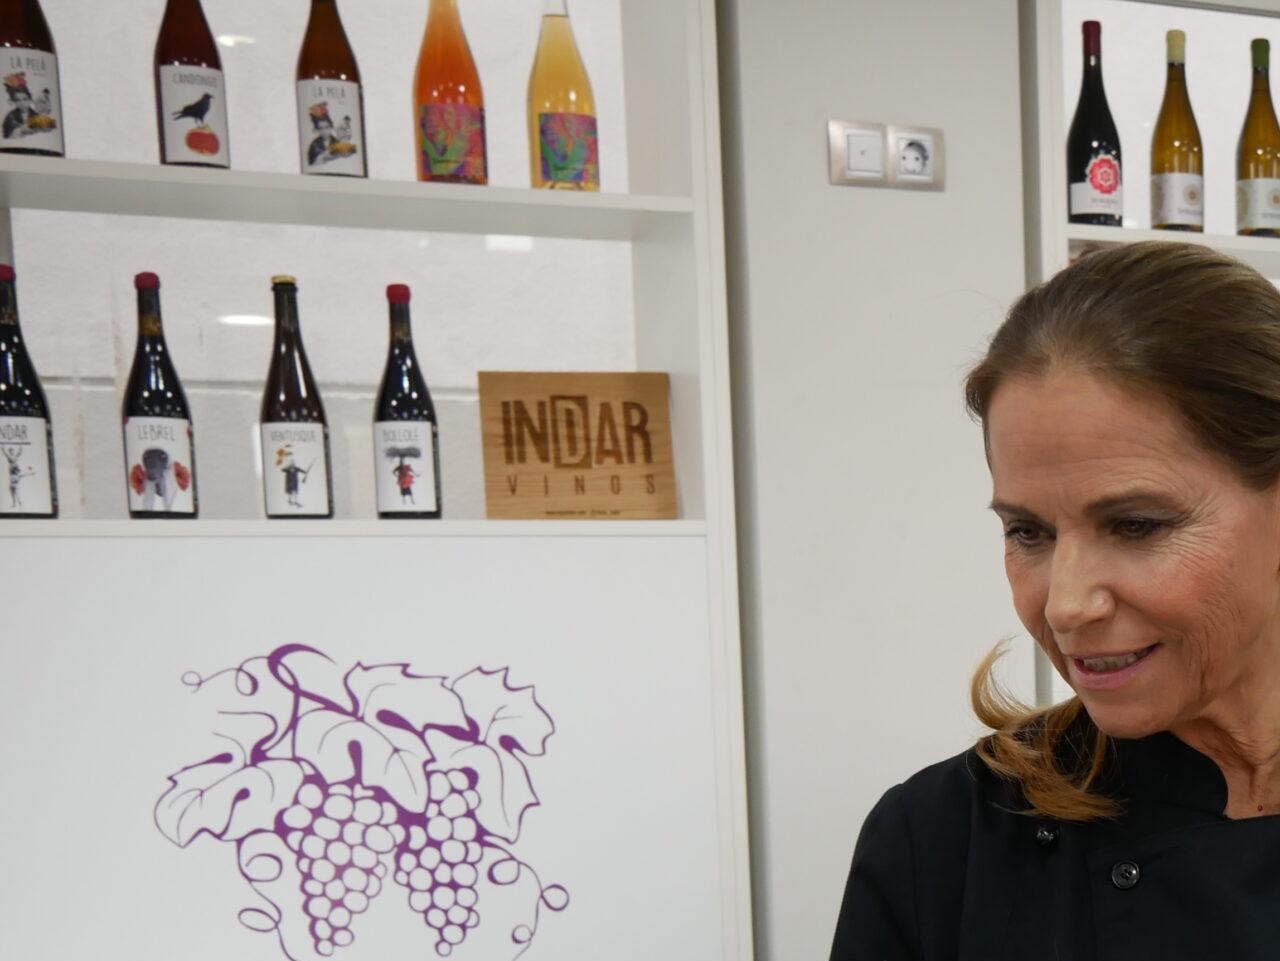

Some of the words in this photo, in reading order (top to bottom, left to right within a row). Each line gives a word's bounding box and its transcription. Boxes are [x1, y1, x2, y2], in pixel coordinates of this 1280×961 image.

[136, 424, 177, 443] LEBREL
[501, 395, 653, 469] INDAR
[507, 474, 656, 495] VINOS
